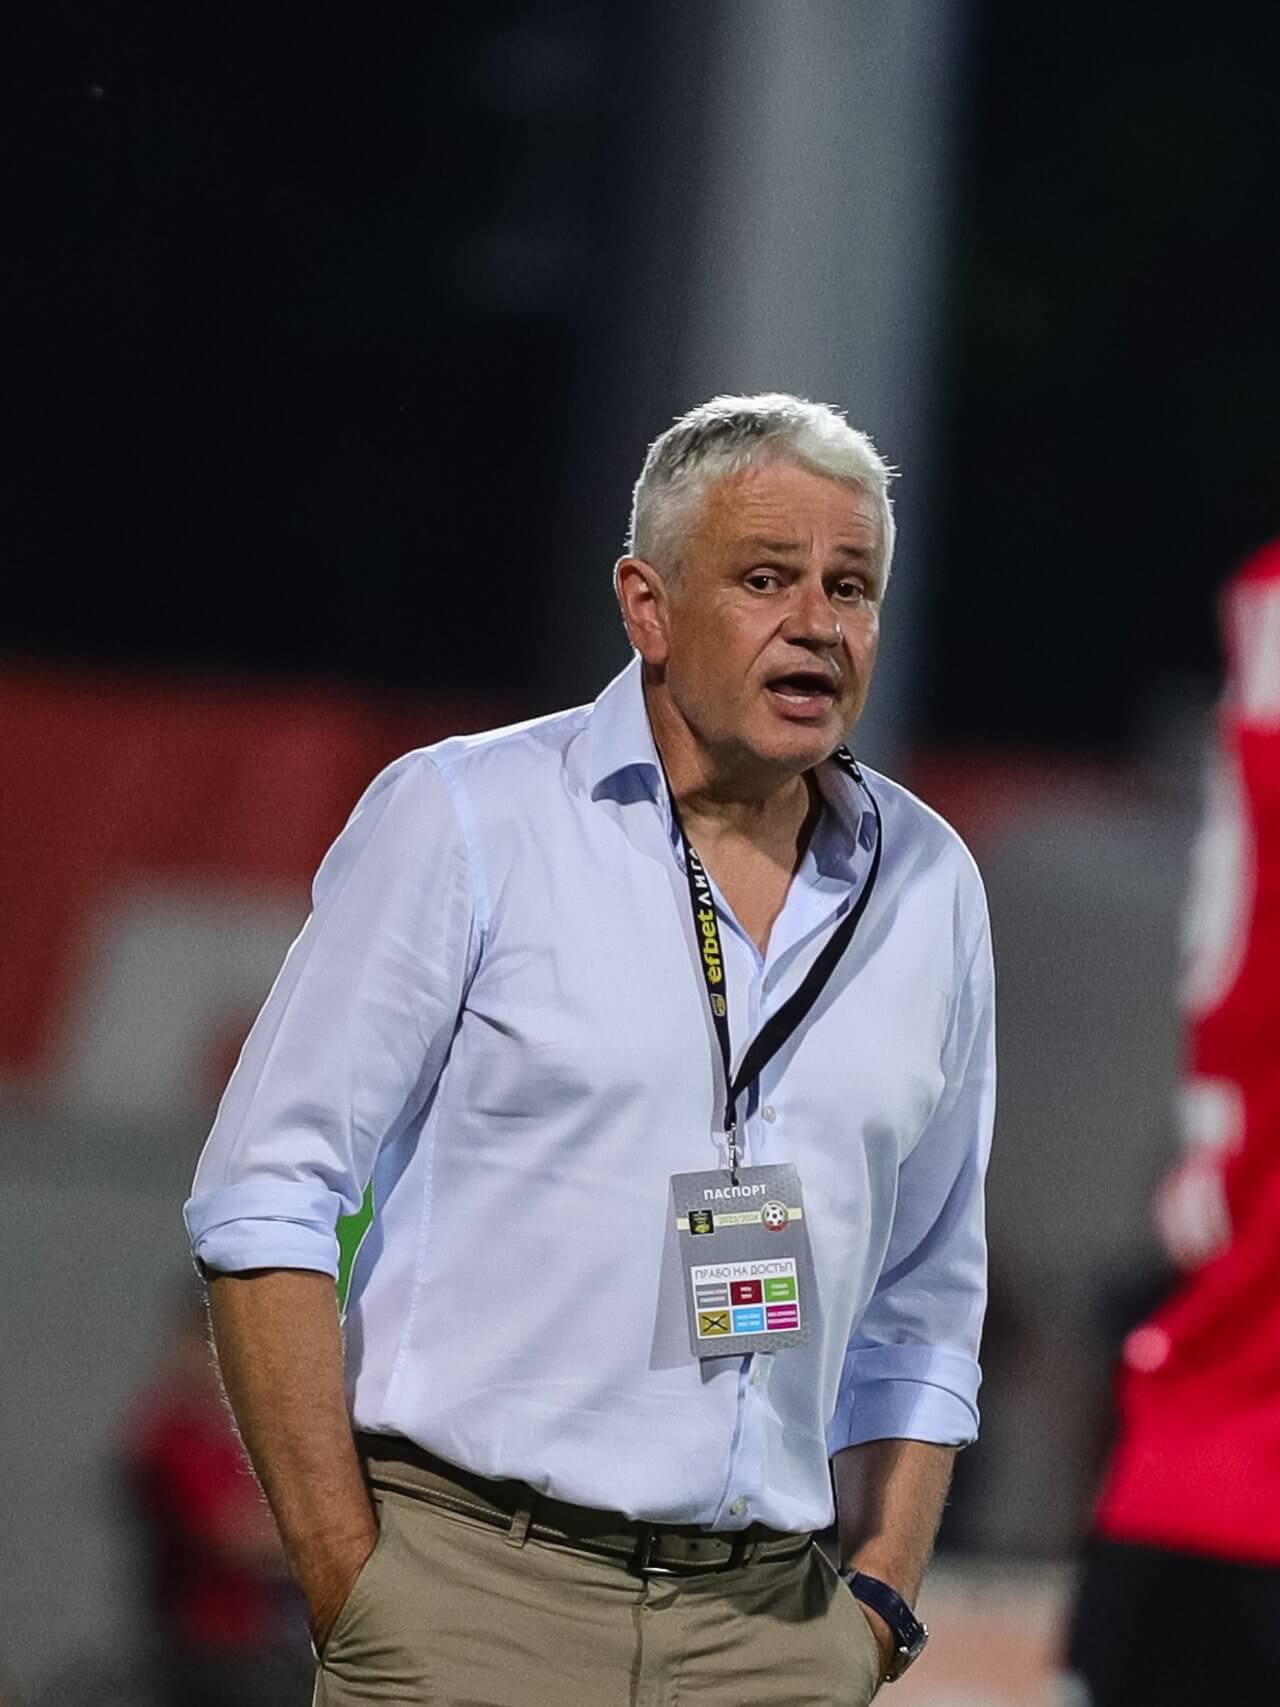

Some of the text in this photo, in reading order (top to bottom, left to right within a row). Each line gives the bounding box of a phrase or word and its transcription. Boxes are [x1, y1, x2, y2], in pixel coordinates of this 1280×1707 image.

[698, 909, 722, 984] efbet
[703, 1184, 767, 1200] ПАСПОРТ
[695, 1262, 793, 1279] ПРАВО НА ДОСТЪП
